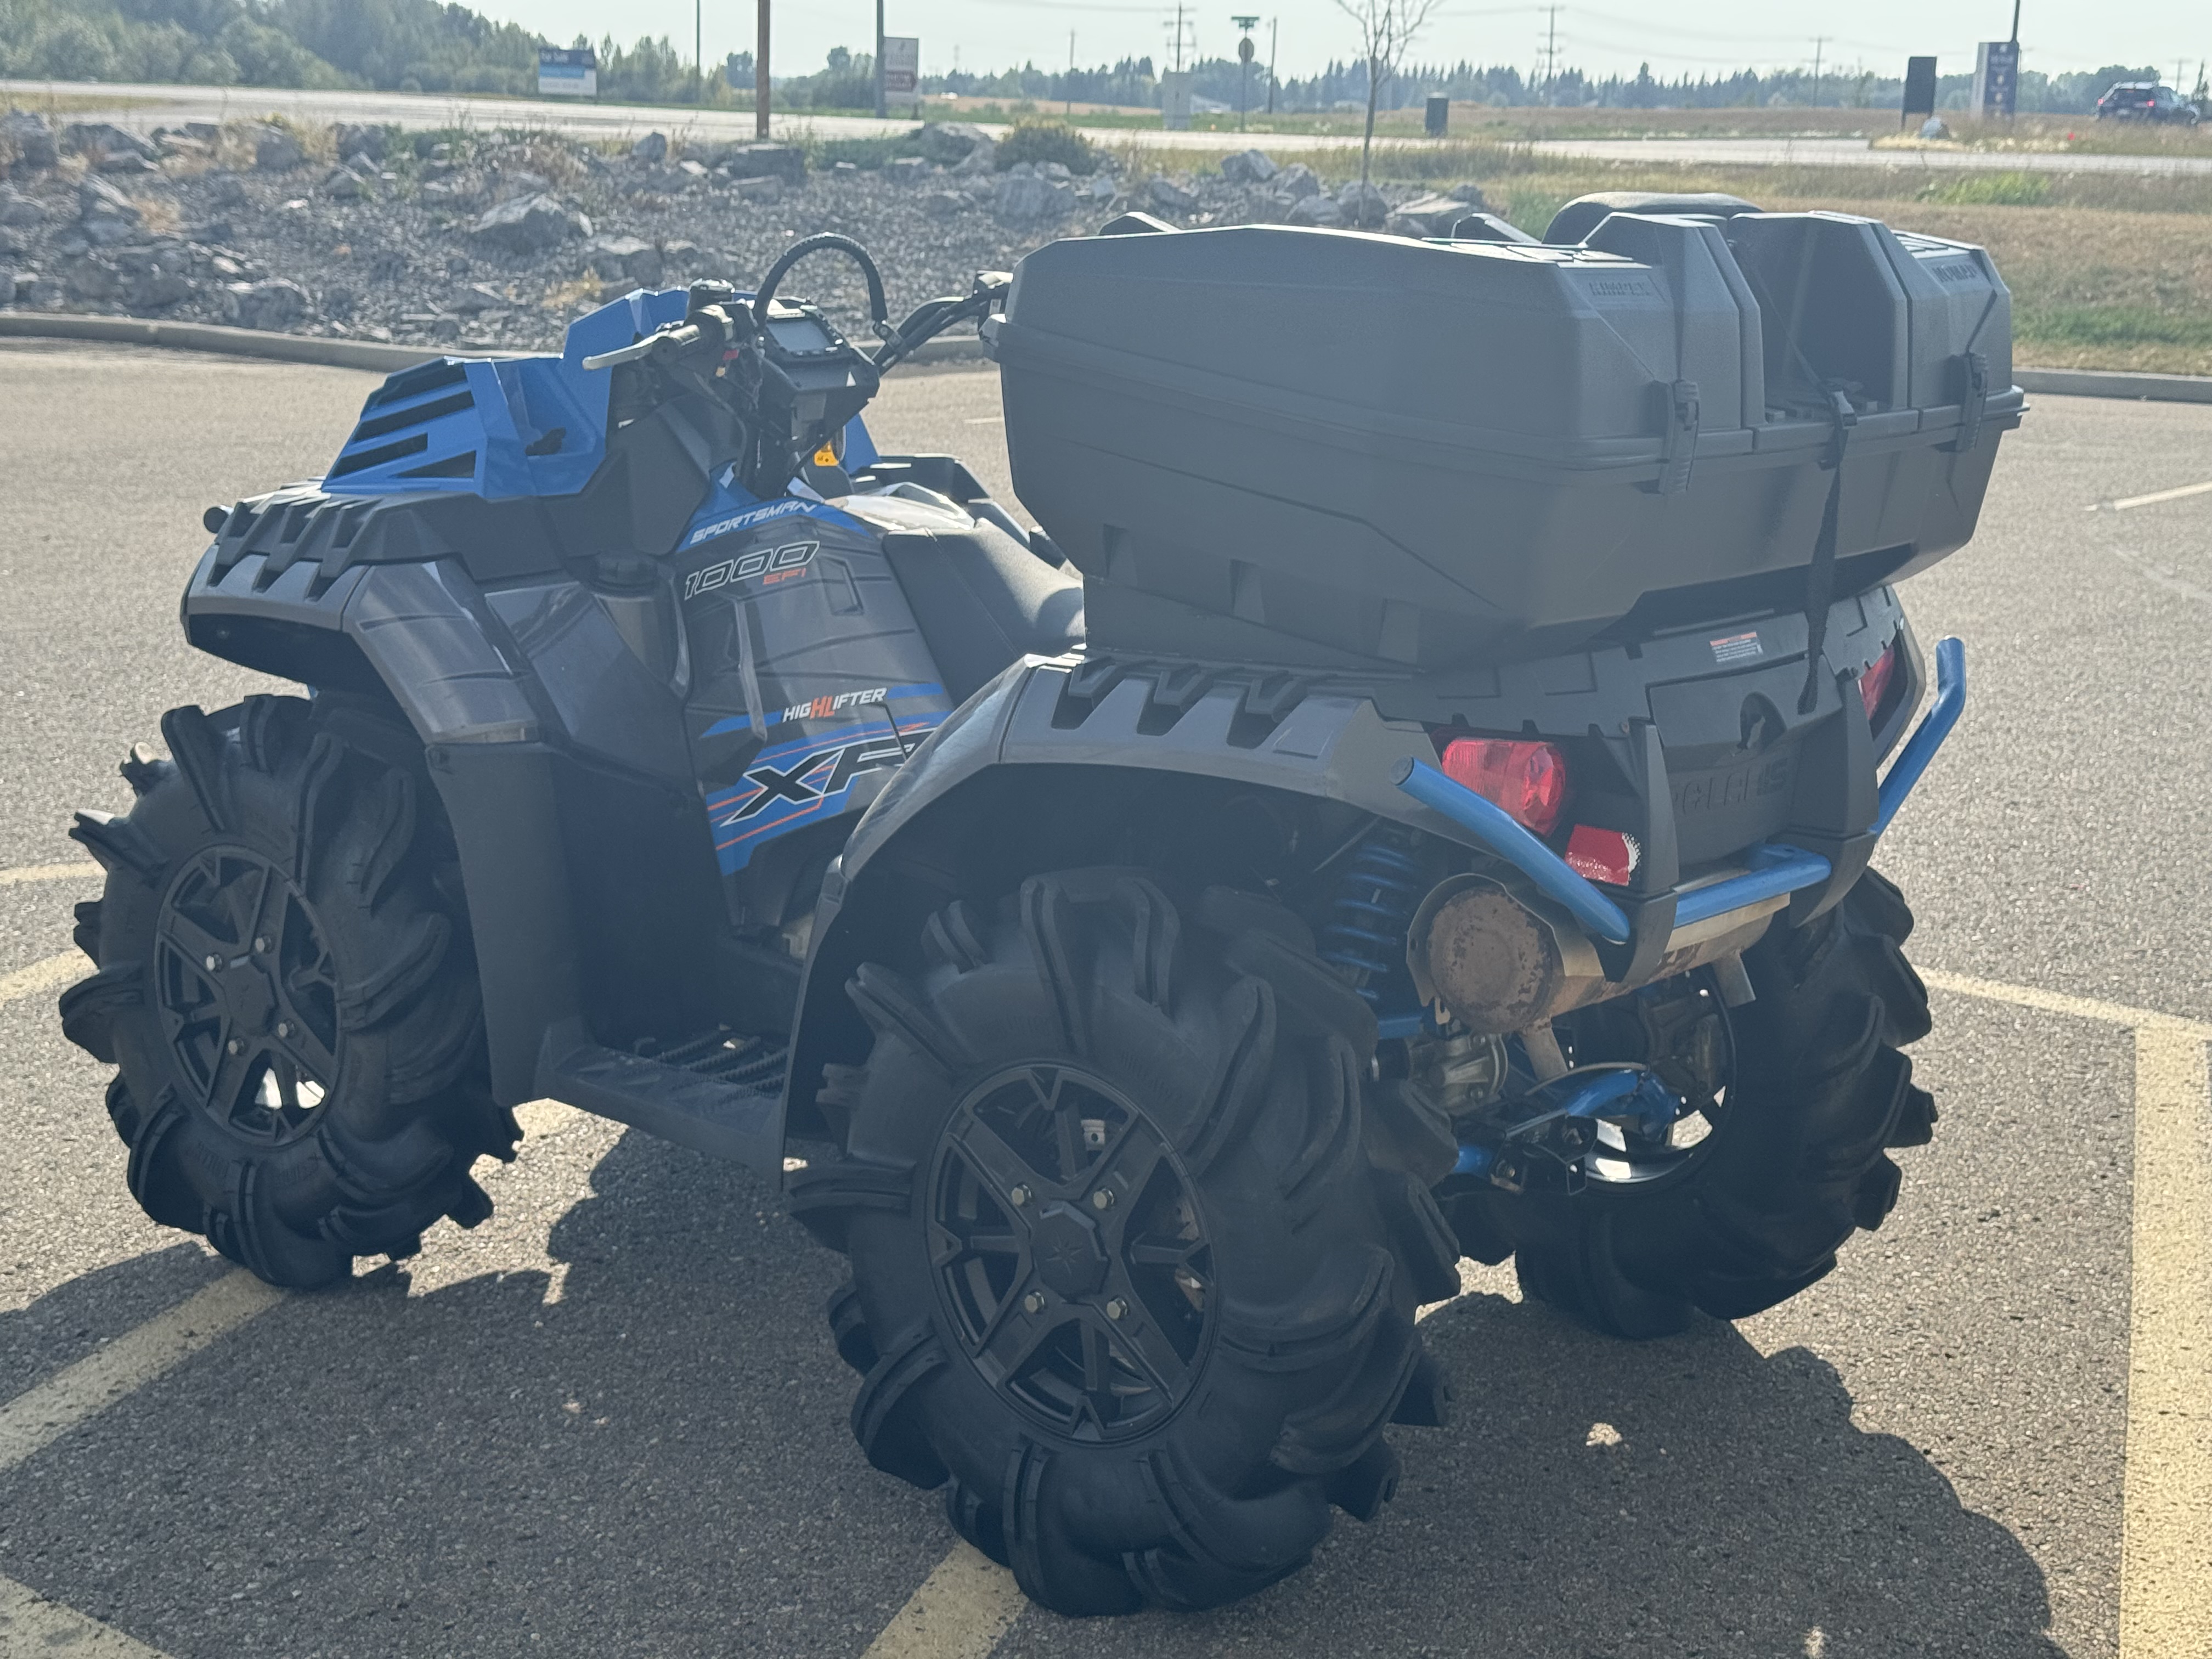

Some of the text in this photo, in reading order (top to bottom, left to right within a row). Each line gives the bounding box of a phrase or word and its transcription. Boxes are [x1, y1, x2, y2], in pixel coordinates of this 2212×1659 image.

[690, 500, 817, 545] SPORTSMAN
[684, 540, 820, 601] 1000
[763, 567, 806, 585] EFI
[782, 687, 888, 724] HIGHLIFTER
